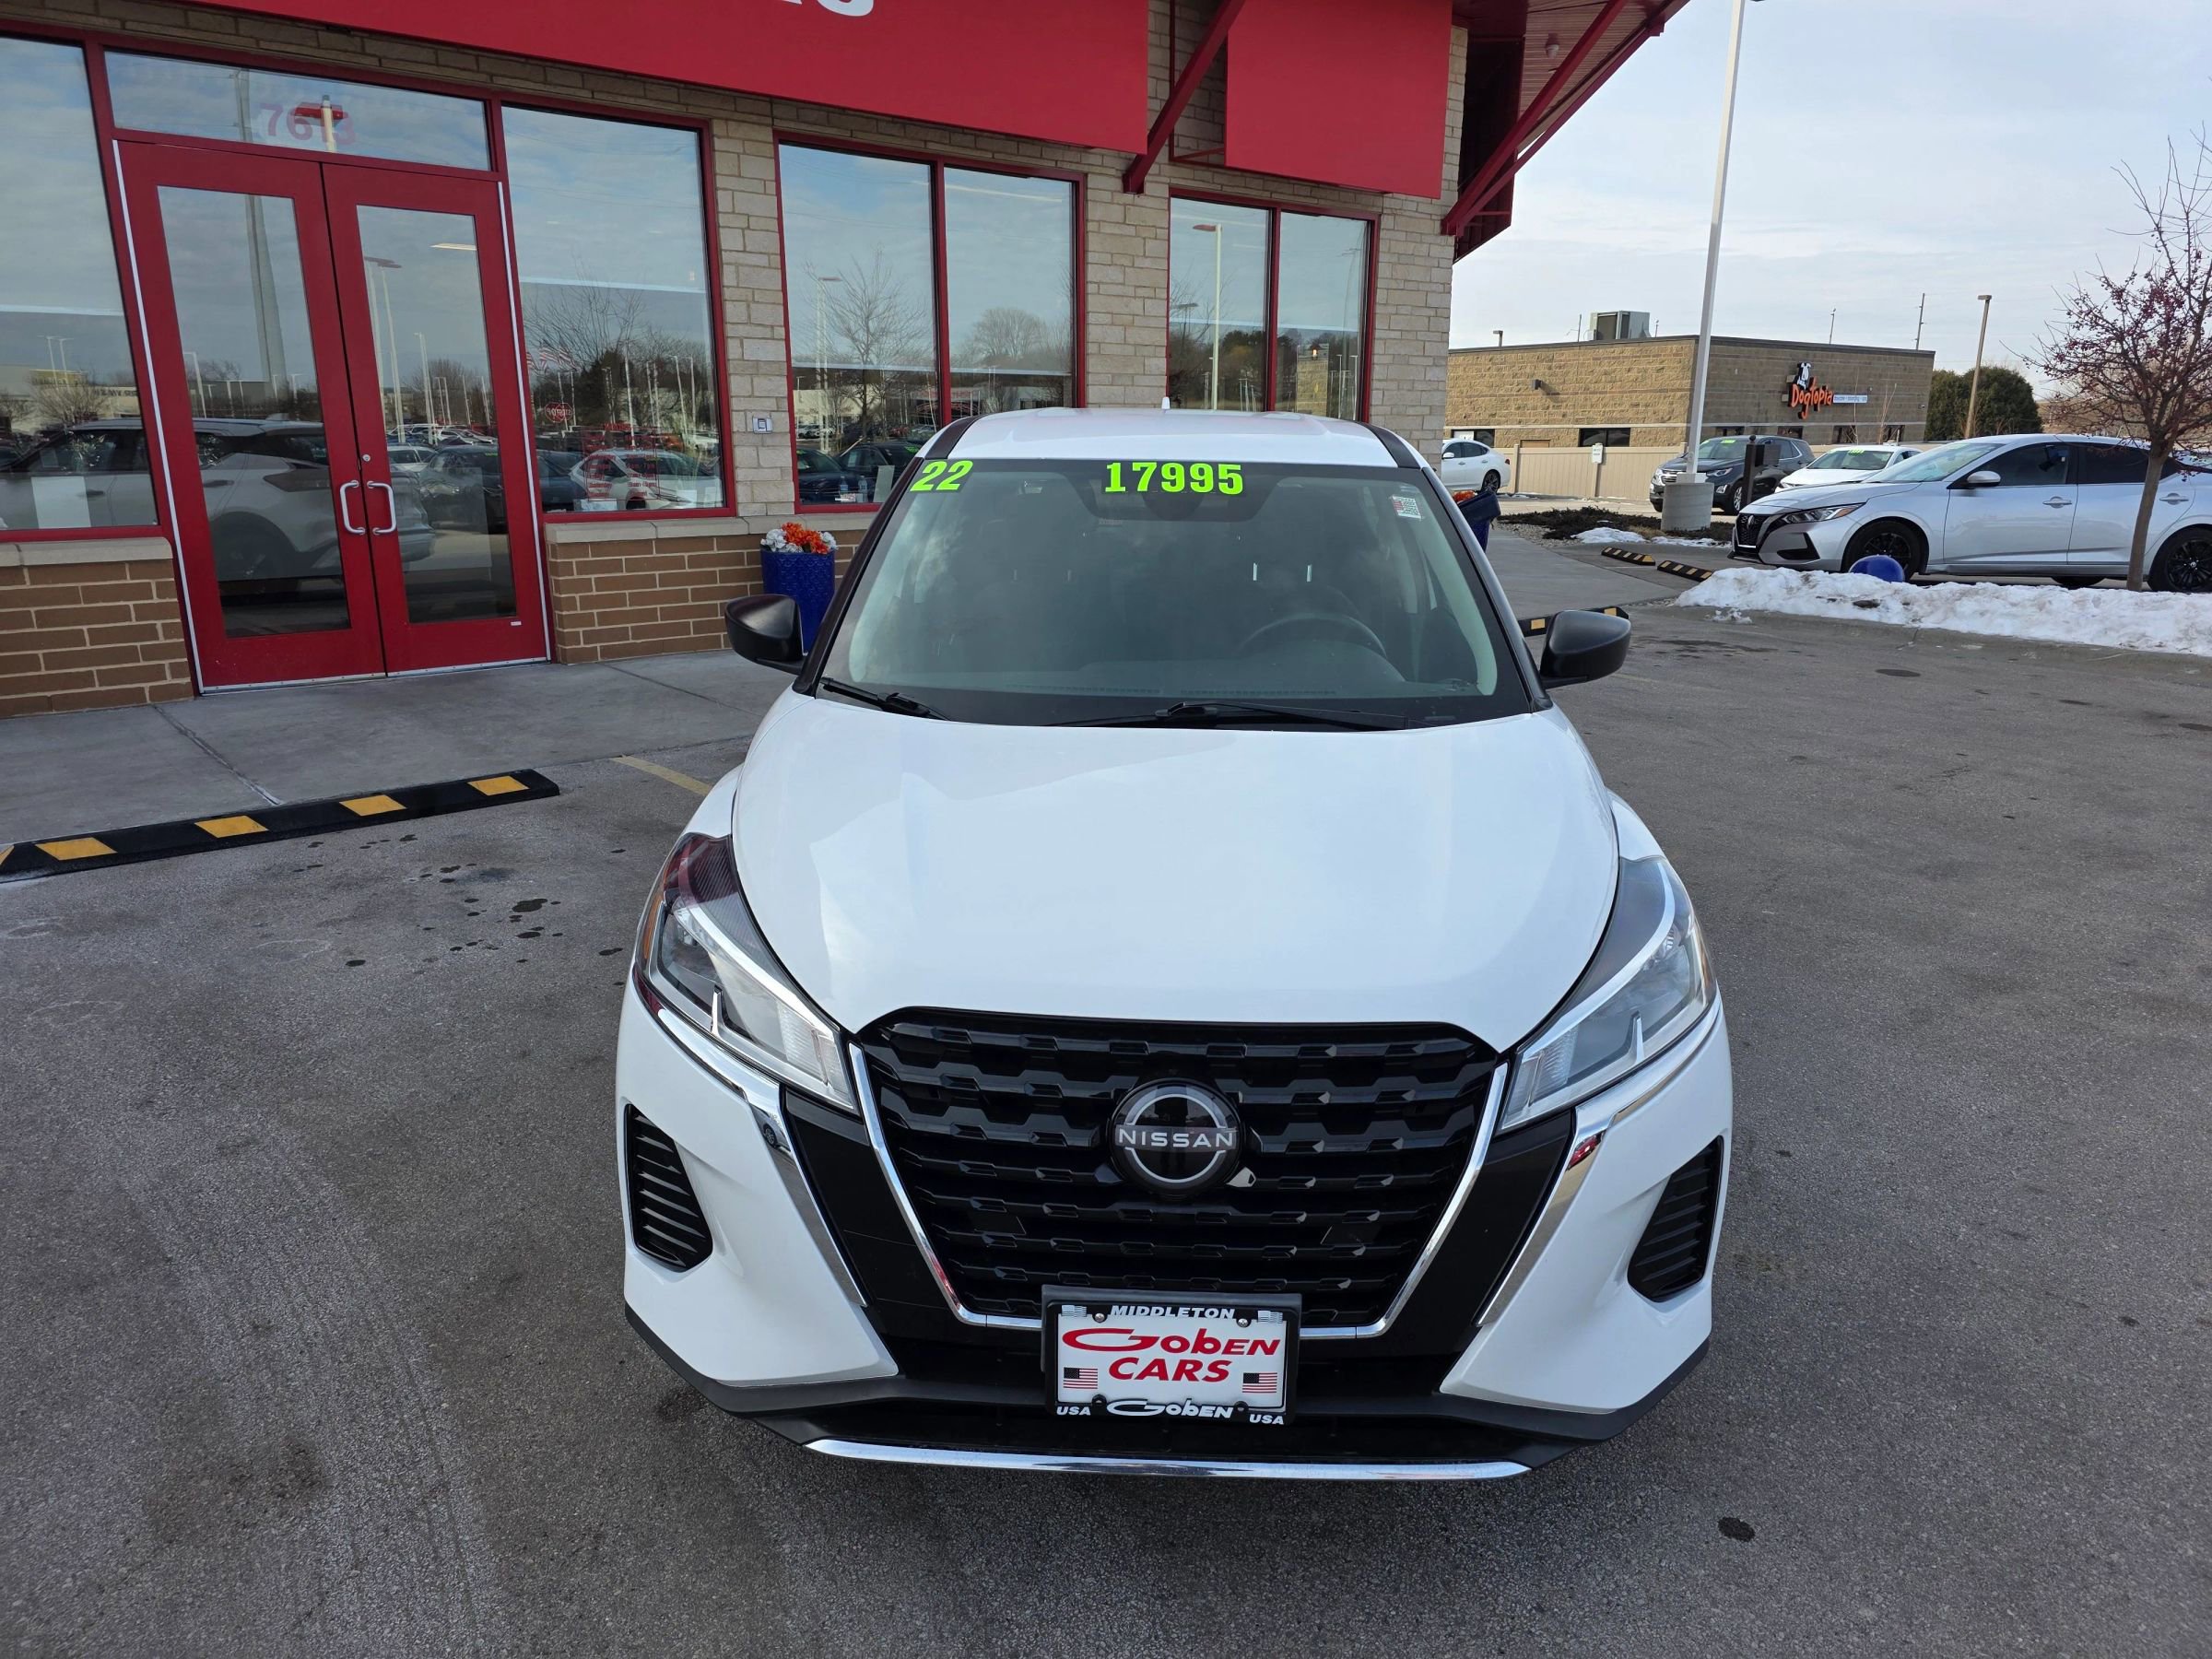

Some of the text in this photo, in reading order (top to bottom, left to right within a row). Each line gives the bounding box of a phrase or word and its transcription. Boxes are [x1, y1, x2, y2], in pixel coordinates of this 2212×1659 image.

[1791, 376, 1833, 419] Dogtopia
[910, 460, 973, 491] 22
[1105, 462, 1243, 495] 17995
[1119, 1128, 1233, 1148] NISSAN
[1110, 1305, 1236, 1320] MIDDLETON
[1109, 1357, 1232, 1382] CARS
[1056, 1406, 1091, 1416] USA
[1249, 1414, 1285, 1425] USA
